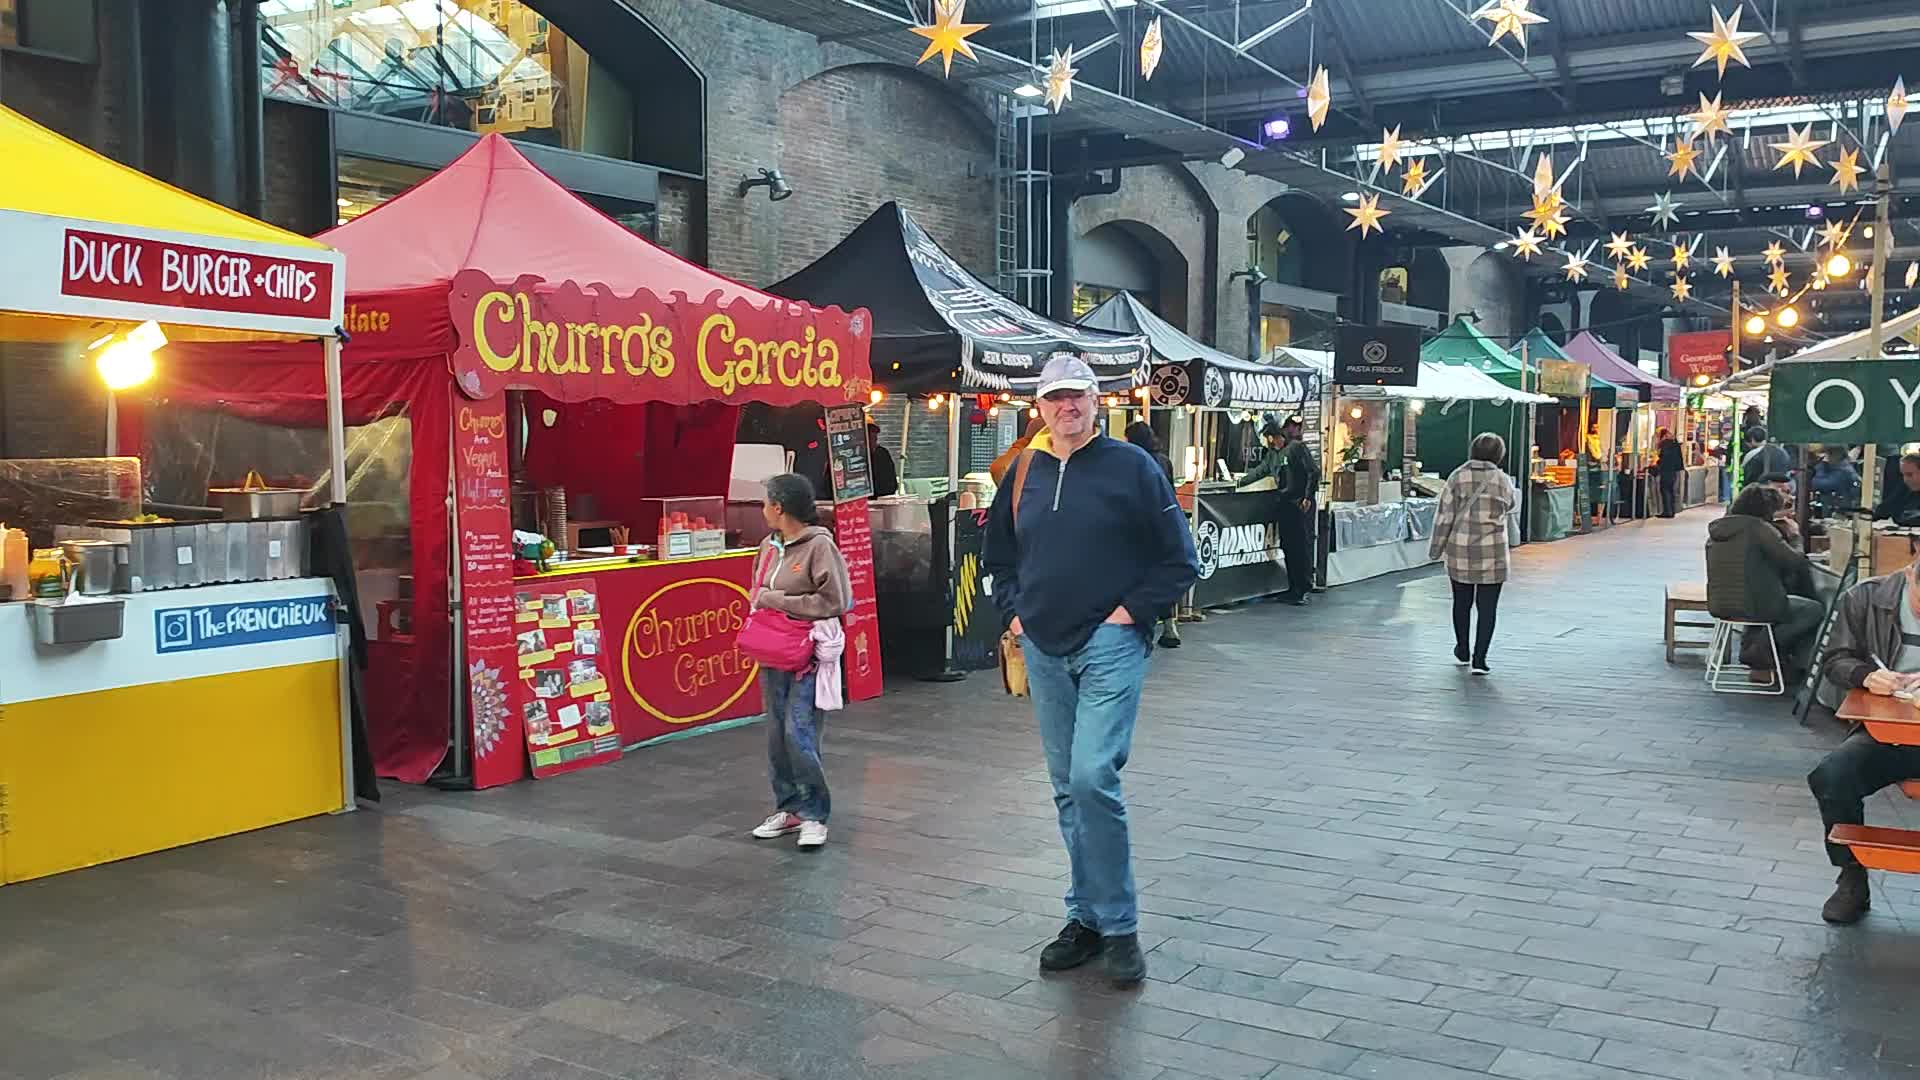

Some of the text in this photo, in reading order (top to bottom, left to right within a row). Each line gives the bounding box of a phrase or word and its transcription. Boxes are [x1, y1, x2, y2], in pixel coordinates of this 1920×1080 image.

[68, 235, 143, 287] DUCK
[473, 291, 843, 395] Churros Garcia
[1680, 353, 1723, 364] Georgian
[1346, 364, 1404, 374] PASTA FRESCA
[1229, 371, 1304, 403] MANDALA
[463, 445, 499, 476] Vegan
[633, 600, 743, 659] Churros
